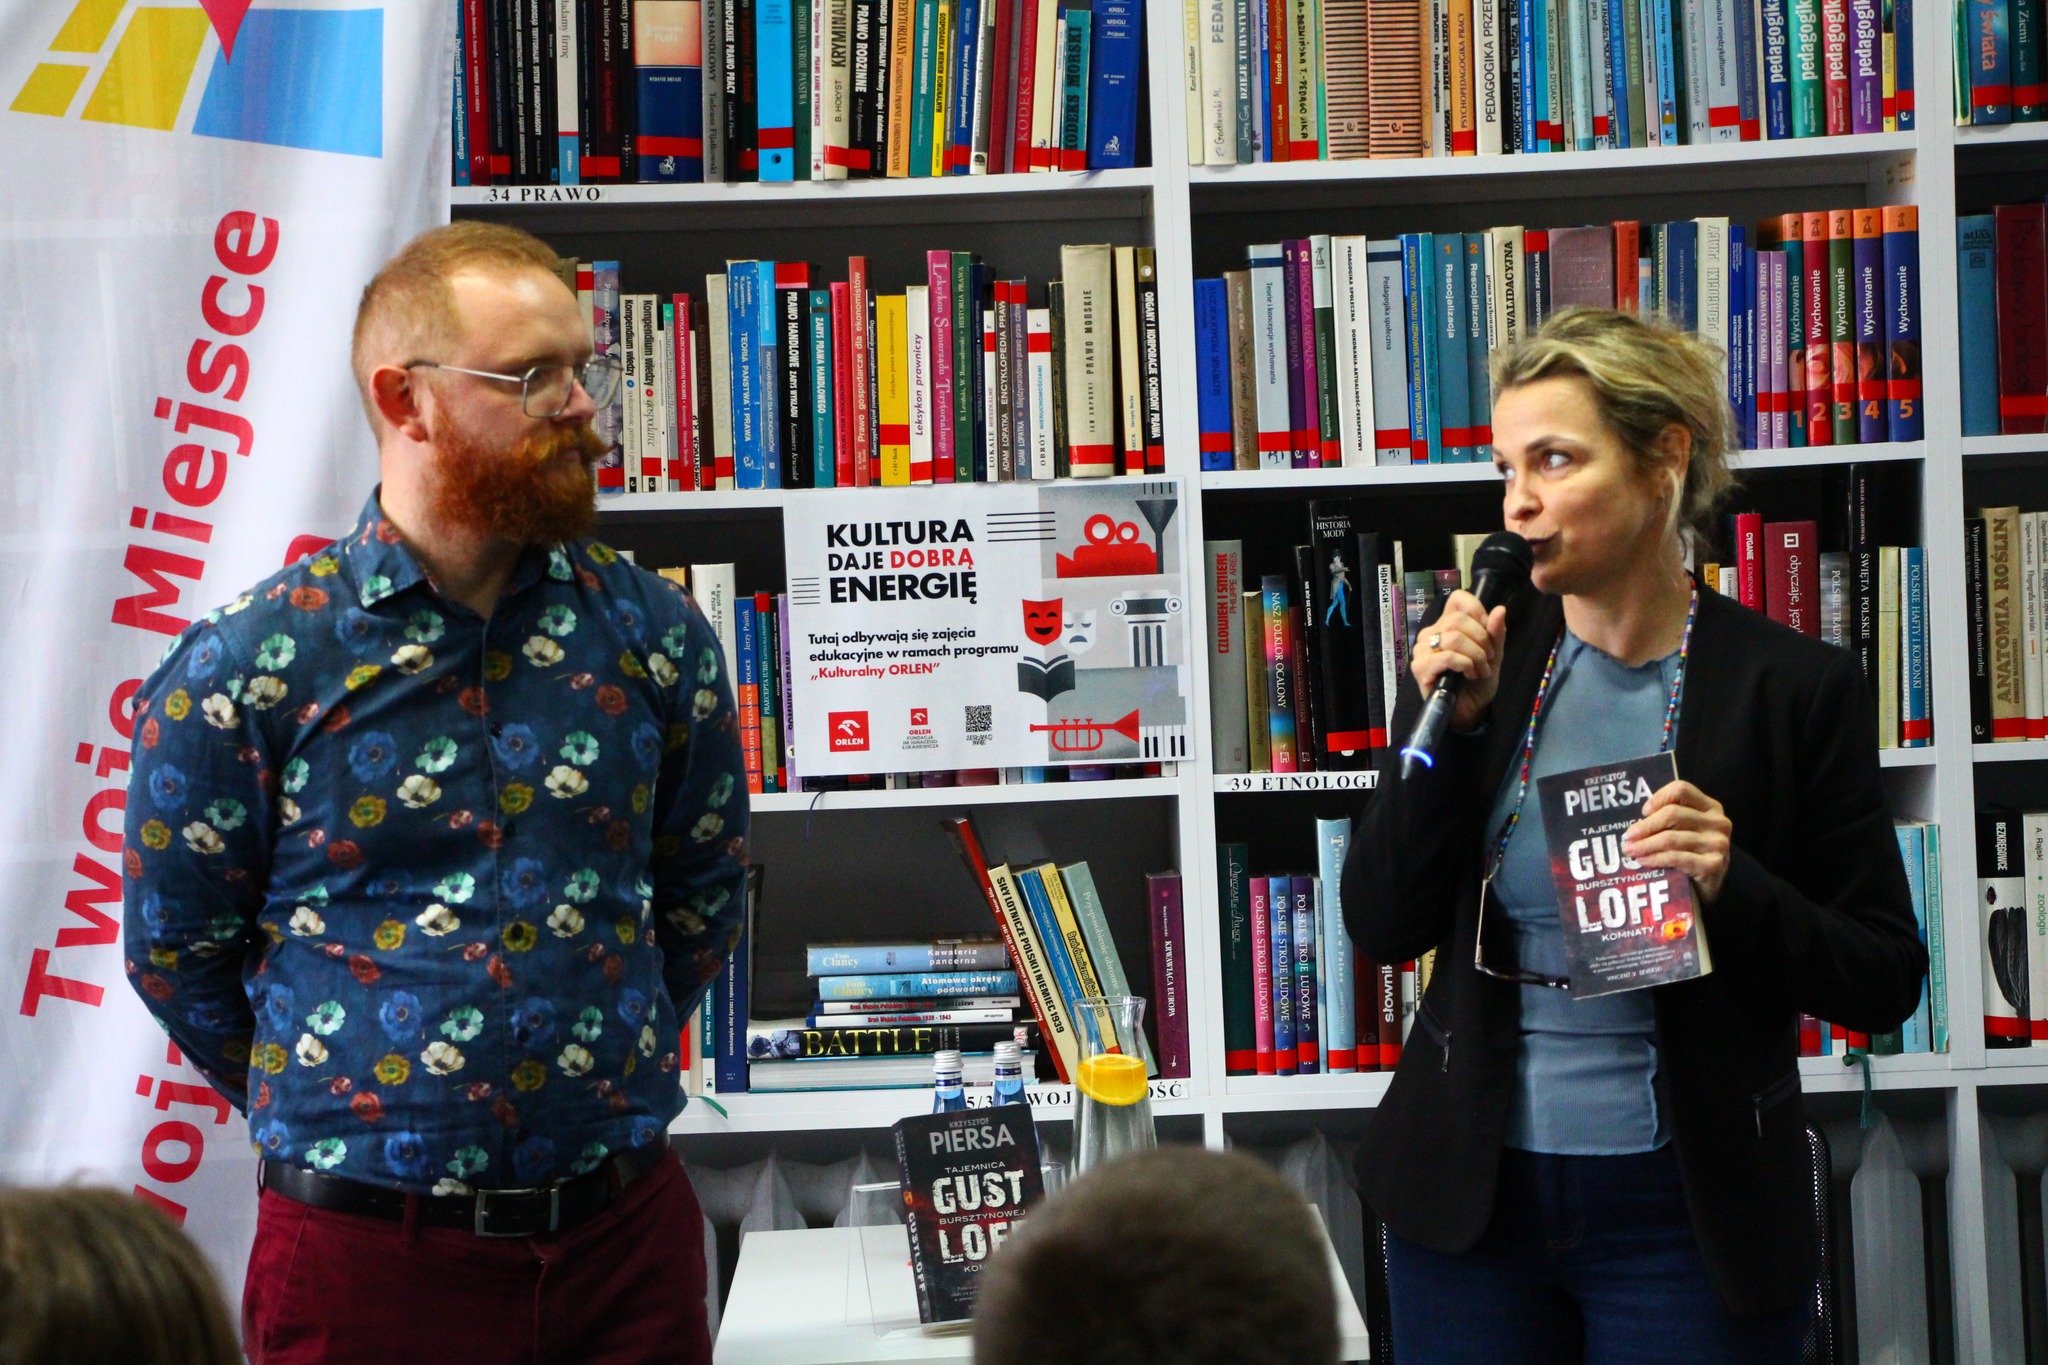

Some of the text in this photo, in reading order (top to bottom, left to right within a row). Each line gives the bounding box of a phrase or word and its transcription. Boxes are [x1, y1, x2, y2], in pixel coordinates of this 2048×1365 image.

[856, 5, 869, 40] PRAWO
[938, 13, 946, 50] GOSPODARKA
[1981, 10, 2000, 71] świata
[2019, 10, 2030, 43] Ziemi
[708, 20, 716, 81] HANDLOWY
[855, 42, 869, 92] RODZINNE
[937, 52, 945, 74] MIENIEM
[1066, 26, 1082, 87] MORSKI
[1459, 41, 1467, 128] PSYCHOPEDAGOGIKA
[1485, 41, 1495, 123] PEDAGOGIKA
[490, 187, 601, 201] 34 PRAWO
[1144, 292, 1155, 322] ORGANY
[1266, 282, 1274, 303] Teorie
[1470, 244, 1481, 338] 2 Resocjalizacja
[1267, 308, 1276, 341] koncepcje
[1382, 276, 1393, 351] Pedagogika społeczna
[624, 299, 636, 376] Kompendium wiedzy
[741, 332, 749, 362] TEORIA
[853, 272, 866, 443] Prawo gospodarcze dla ekonomistów
[933, 263, 950, 452] Leksykon Samorządu Terytorialnego
[1147, 329, 1158, 375] KORPORACJE
[1811, 270, 1826, 421] Wychowanie 2
[1837, 267, 1852, 420] Wychowanie 3
[1864, 267, 1880, 419] Wychowanie 4
[1898, 266, 1914, 418] Wychowanie 5
[1268, 343, 1278, 384] wychowania
[741, 365, 751, 405] PAŃSTWA
[914, 334, 924, 436] Leksykon prawniczy
[1149, 377, 1159, 411] OCHRONY
[108, 210, 279, 634] Miejsce
[1151, 413, 1161, 438] PRAWA
[827, 519, 974, 548] KULTURA
[1316, 522, 1352, 530] HISTORIA
[1322, 530, 1346, 538] MODY
[828, 548, 975, 571] DAJE DOBRĄ
[830, 572, 978, 605] ENERGIĘ
[1229, 581, 1237, 613] PHILIPPE
[1789, 555, 1802, 605] obyczaje,
[1911, 564, 1920, 603] POLSKIE
[1832, 570, 1842, 647] POLSKIE TRADYC
[1912, 606, 1921, 635] HAFTY
[1973, 526, 1985, 676] Wprowadzenie do ekologii behawioralnej
[1990, 518, 2012, 703] ANATOMIA ROŚLIN
[808, 626, 977, 647] Tutaj odbywają się zajęcia
[809, 643, 1019, 664] edukacyjne w ramach programu
[1272, 592, 1286, 708] NASZ FOLKLOR OCALONY
[1913, 645, 1922, 689] KORONKI
[835, 738, 864, 746] ORLEN
[1231, 775, 1377, 790] 39 ETNOLOGI
[1564, 777, 1653, 817] PIERSA
[1584, 771, 1627, 787] KRZYSZTOF
[1567, 832, 1642, 881] GU
[1995, 822, 2007, 870] BEZKRĘGOWCE
[1575, 869, 1665, 892] BURSZTYNOWEJ
[2035, 827, 2048, 936] A. Rajski zoologia
[1574, 880, 1669, 934] LOFF
[927, 948, 978, 957] Kawaleria
[1083, 891, 1119, 990] Przysposobienie obronne
[1601, 925, 1655, 943] KOMNATY
[822, 957, 860, 968] Clancy
[929, 957, 976, 966] pancerna
[996, 876, 1011, 896] SIŁY
[1005, 896, 1027, 938] LOTNICZE
[1021, 936, 1038, 969] POLSKI
[1035, 974, 1055, 1012] NIEMIEC
[1049, 1012, 1065, 1034] 1939
[1255, 895, 1269, 1022] POLSKIE STROJE LUDOWE
[1277, 896, 1290, 1034] POLSKIE STROJE LUDOWE 2
[1297, 894, 1310, 1032] POLSKIE STROJE LUDOWE 3
[846, 980, 866, 988] Tom
[922, 975, 1002, 985] Atomowe okręty
[937, 985, 987, 994] podwodne
[1165, 941, 1176, 1017] KRWAWIĄCA EUROPA
[1381, 965, 1394, 1023] słownik
[803, 1027, 933, 1056] BATTLE
[929, 1123, 1016, 1155] PIERSA
[949, 1117, 990, 1129] KRZYSZTOF
[944, 1161, 1006, 1175] TAJEMNICA
[931, 1169, 1024, 1215] GUST
[939, 1209, 1026, 1226] BURSZTYNOWEJ
[907, 1211, 927, 1292] GUSTLOFF
[938, 1219, 1027, 1265] LOF
